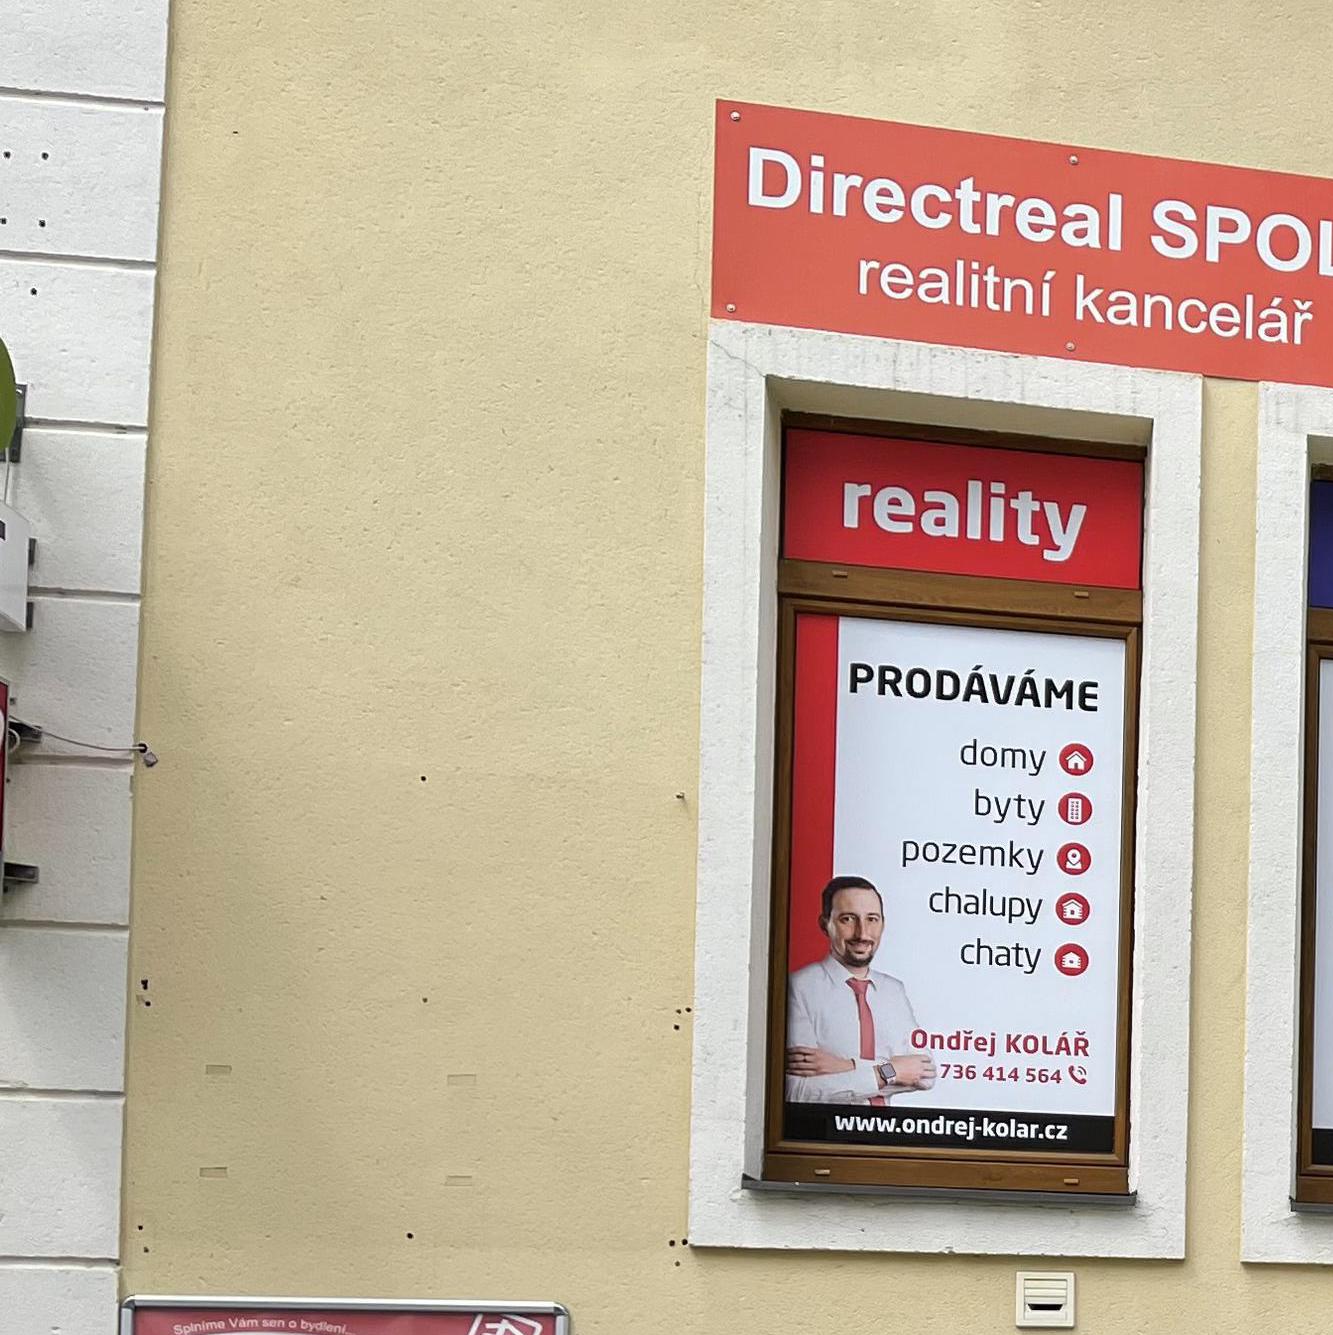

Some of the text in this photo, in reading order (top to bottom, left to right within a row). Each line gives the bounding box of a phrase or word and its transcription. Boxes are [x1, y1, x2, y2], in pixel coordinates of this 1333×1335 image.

[746, 147, 1123, 252] Directreal
[857, 256, 1315, 346] realitní kancelář
[843, 480, 1087, 562] reality
[849, 662, 1100, 713] PRODÁVÁME
[960, 738, 1047, 777] domy
[974, 788, 1046, 826] byty
[902, 839, 1044, 876] pozemky
[928, 886, 1043, 925] chalupy
[960, 938, 1042, 975] chaty
[910, 1027, 1090, 1058] Ondřej KOLÁŘ
[940, 1063, 1062, 1084] 736 414 564
[834, 1114, 1068, 1142] www.ondrej-kolar.cz
[173, 1318, 226, 1335] Splníme
[228, 1317, 259, 1329] Vám
[262, 1317, 285, 1328] sen
[288, 1319, 298, 1329] o
